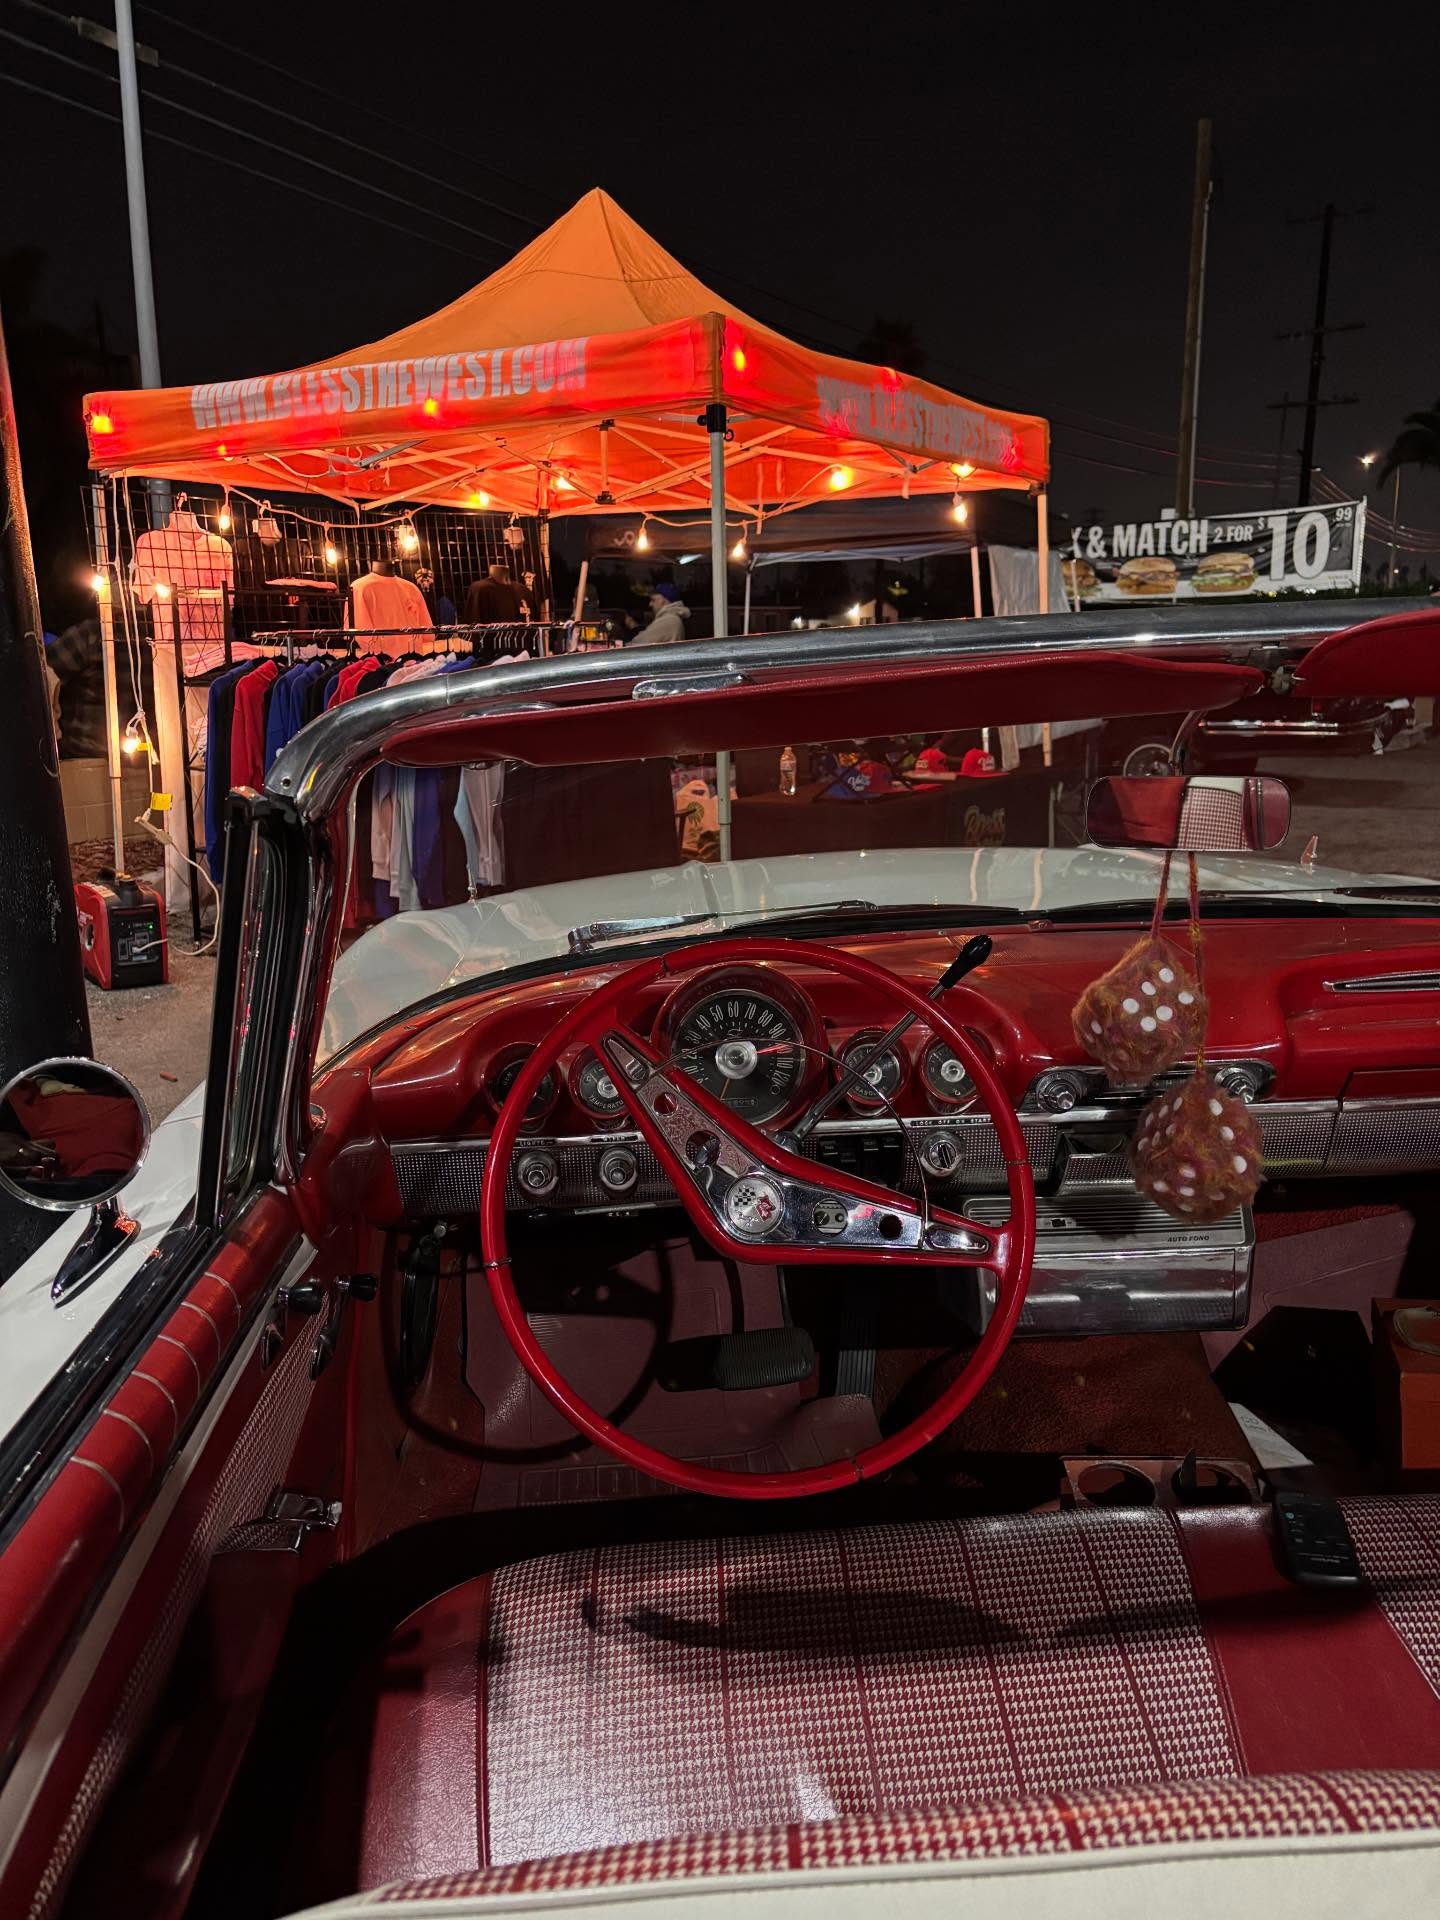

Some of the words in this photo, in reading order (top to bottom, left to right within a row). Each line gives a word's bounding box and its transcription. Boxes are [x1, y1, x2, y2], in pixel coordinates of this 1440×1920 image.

[191, 336, 590, 430] WWW.BLESSTHEWEST.COM
[1086, 525, 1108, 558] &
[1112, 519, 1208, 558] MATCH
[1213, 526, 1224, 543] 2
[1226, 524, 1254, 543] FOR
[1257, 516, 1265, 530] $
[1267, 511, 1331, 581] 10
[709, 1004, 723, 1022] 50
[727, 1000, 740, 1018] 60
[744, 1002, 757, 1020] 70
[757, 1009, 774, 1027] 80
[696, 1014, 711, 1031] 40
[769, 1022, 786, 1038] 90
